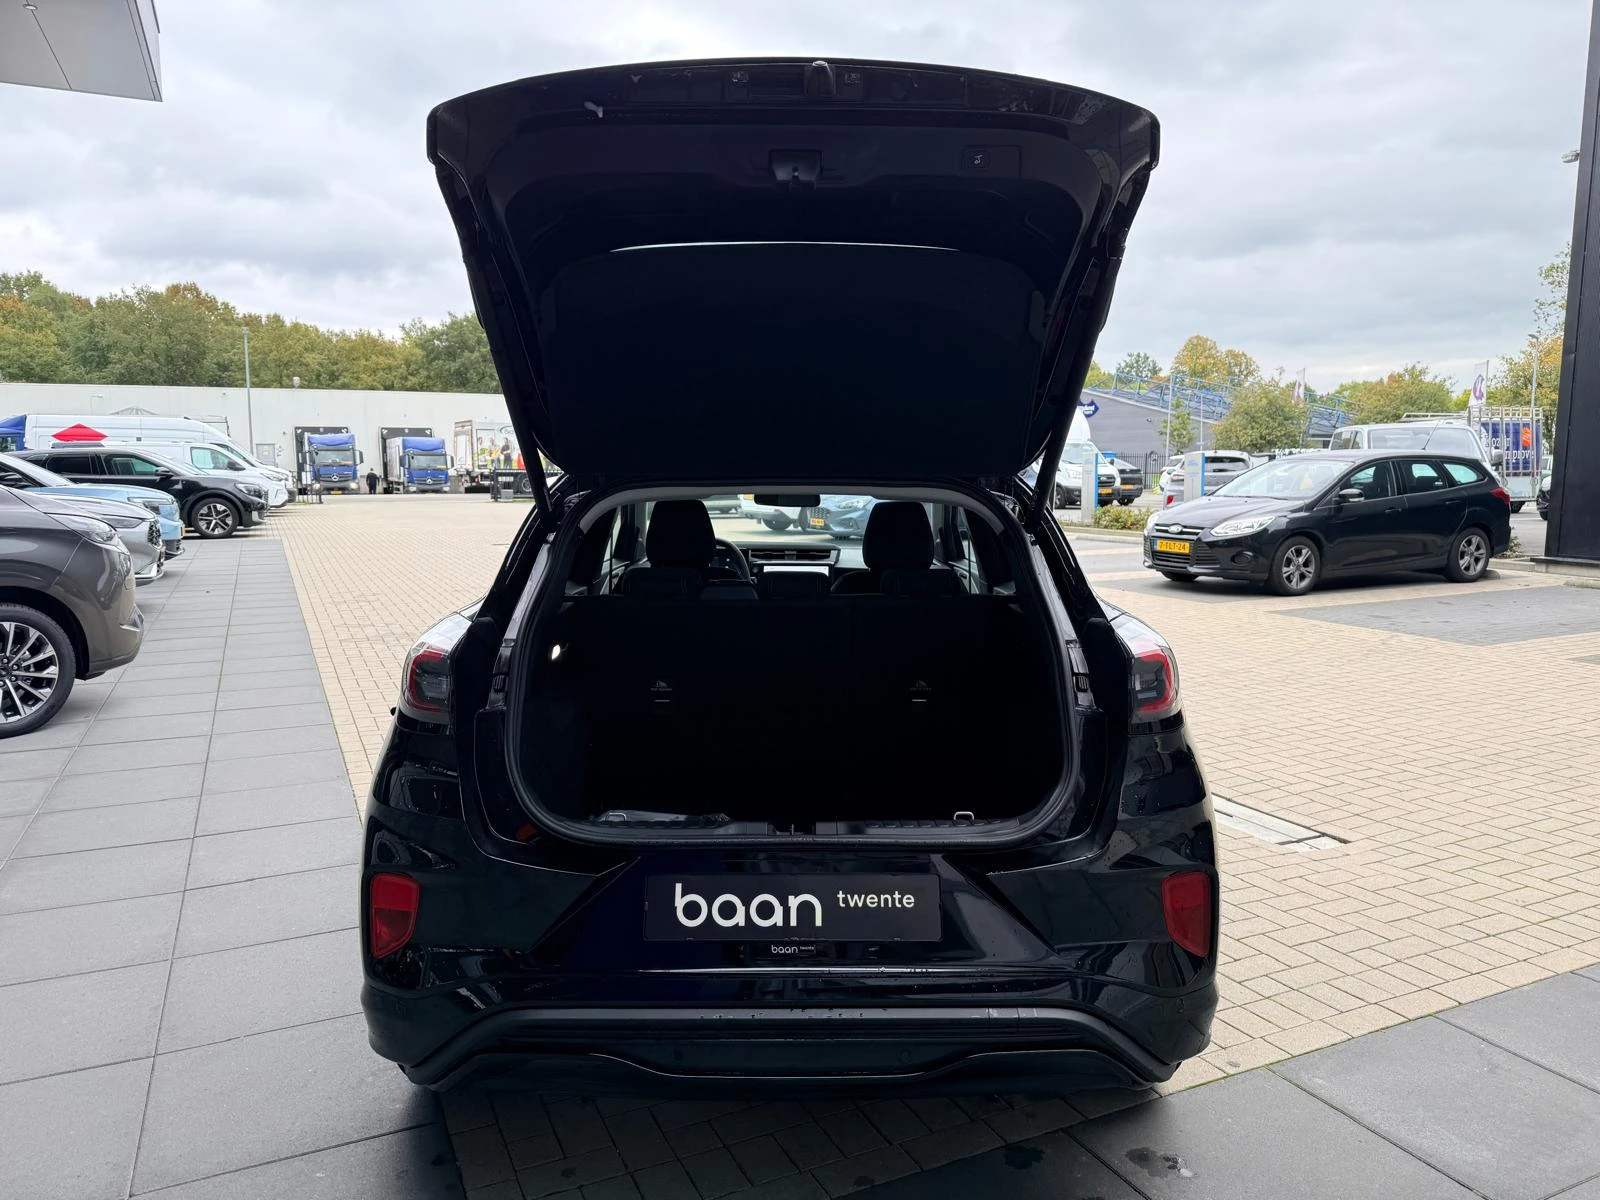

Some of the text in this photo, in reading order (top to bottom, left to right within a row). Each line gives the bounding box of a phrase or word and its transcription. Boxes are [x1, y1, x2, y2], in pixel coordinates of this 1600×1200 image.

[1159, 541, 1186, 551] 7-TLT-24
[674, 882, 916, 928] baan twente
[771, 944, 799, 954] baan
